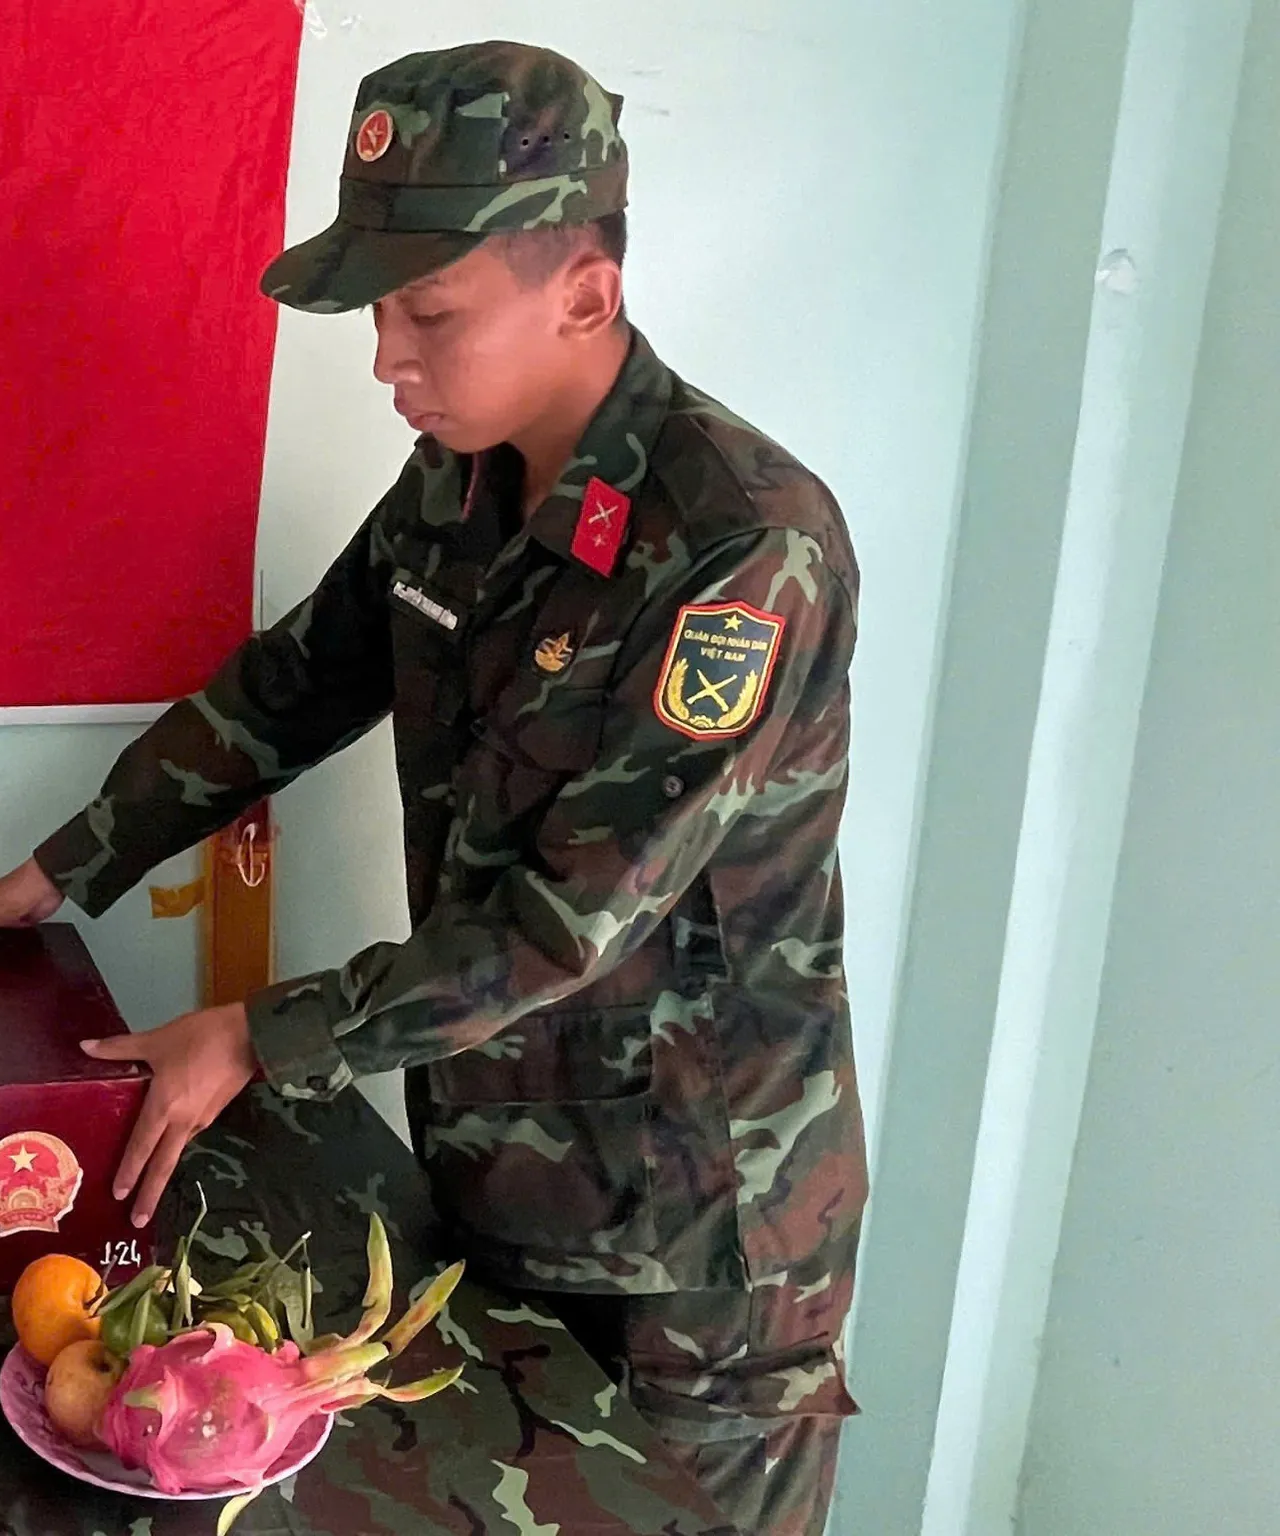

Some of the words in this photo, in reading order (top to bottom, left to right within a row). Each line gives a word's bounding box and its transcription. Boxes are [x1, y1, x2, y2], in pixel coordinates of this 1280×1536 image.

[684, 629, 709, 642] QUÂN
[727, 637, 751, 648] NHÂN
[700, 647, 723, 659] VIỆT
[724, 651, 746, 661] NAM
[99, 1238, 142, 1268] 124
